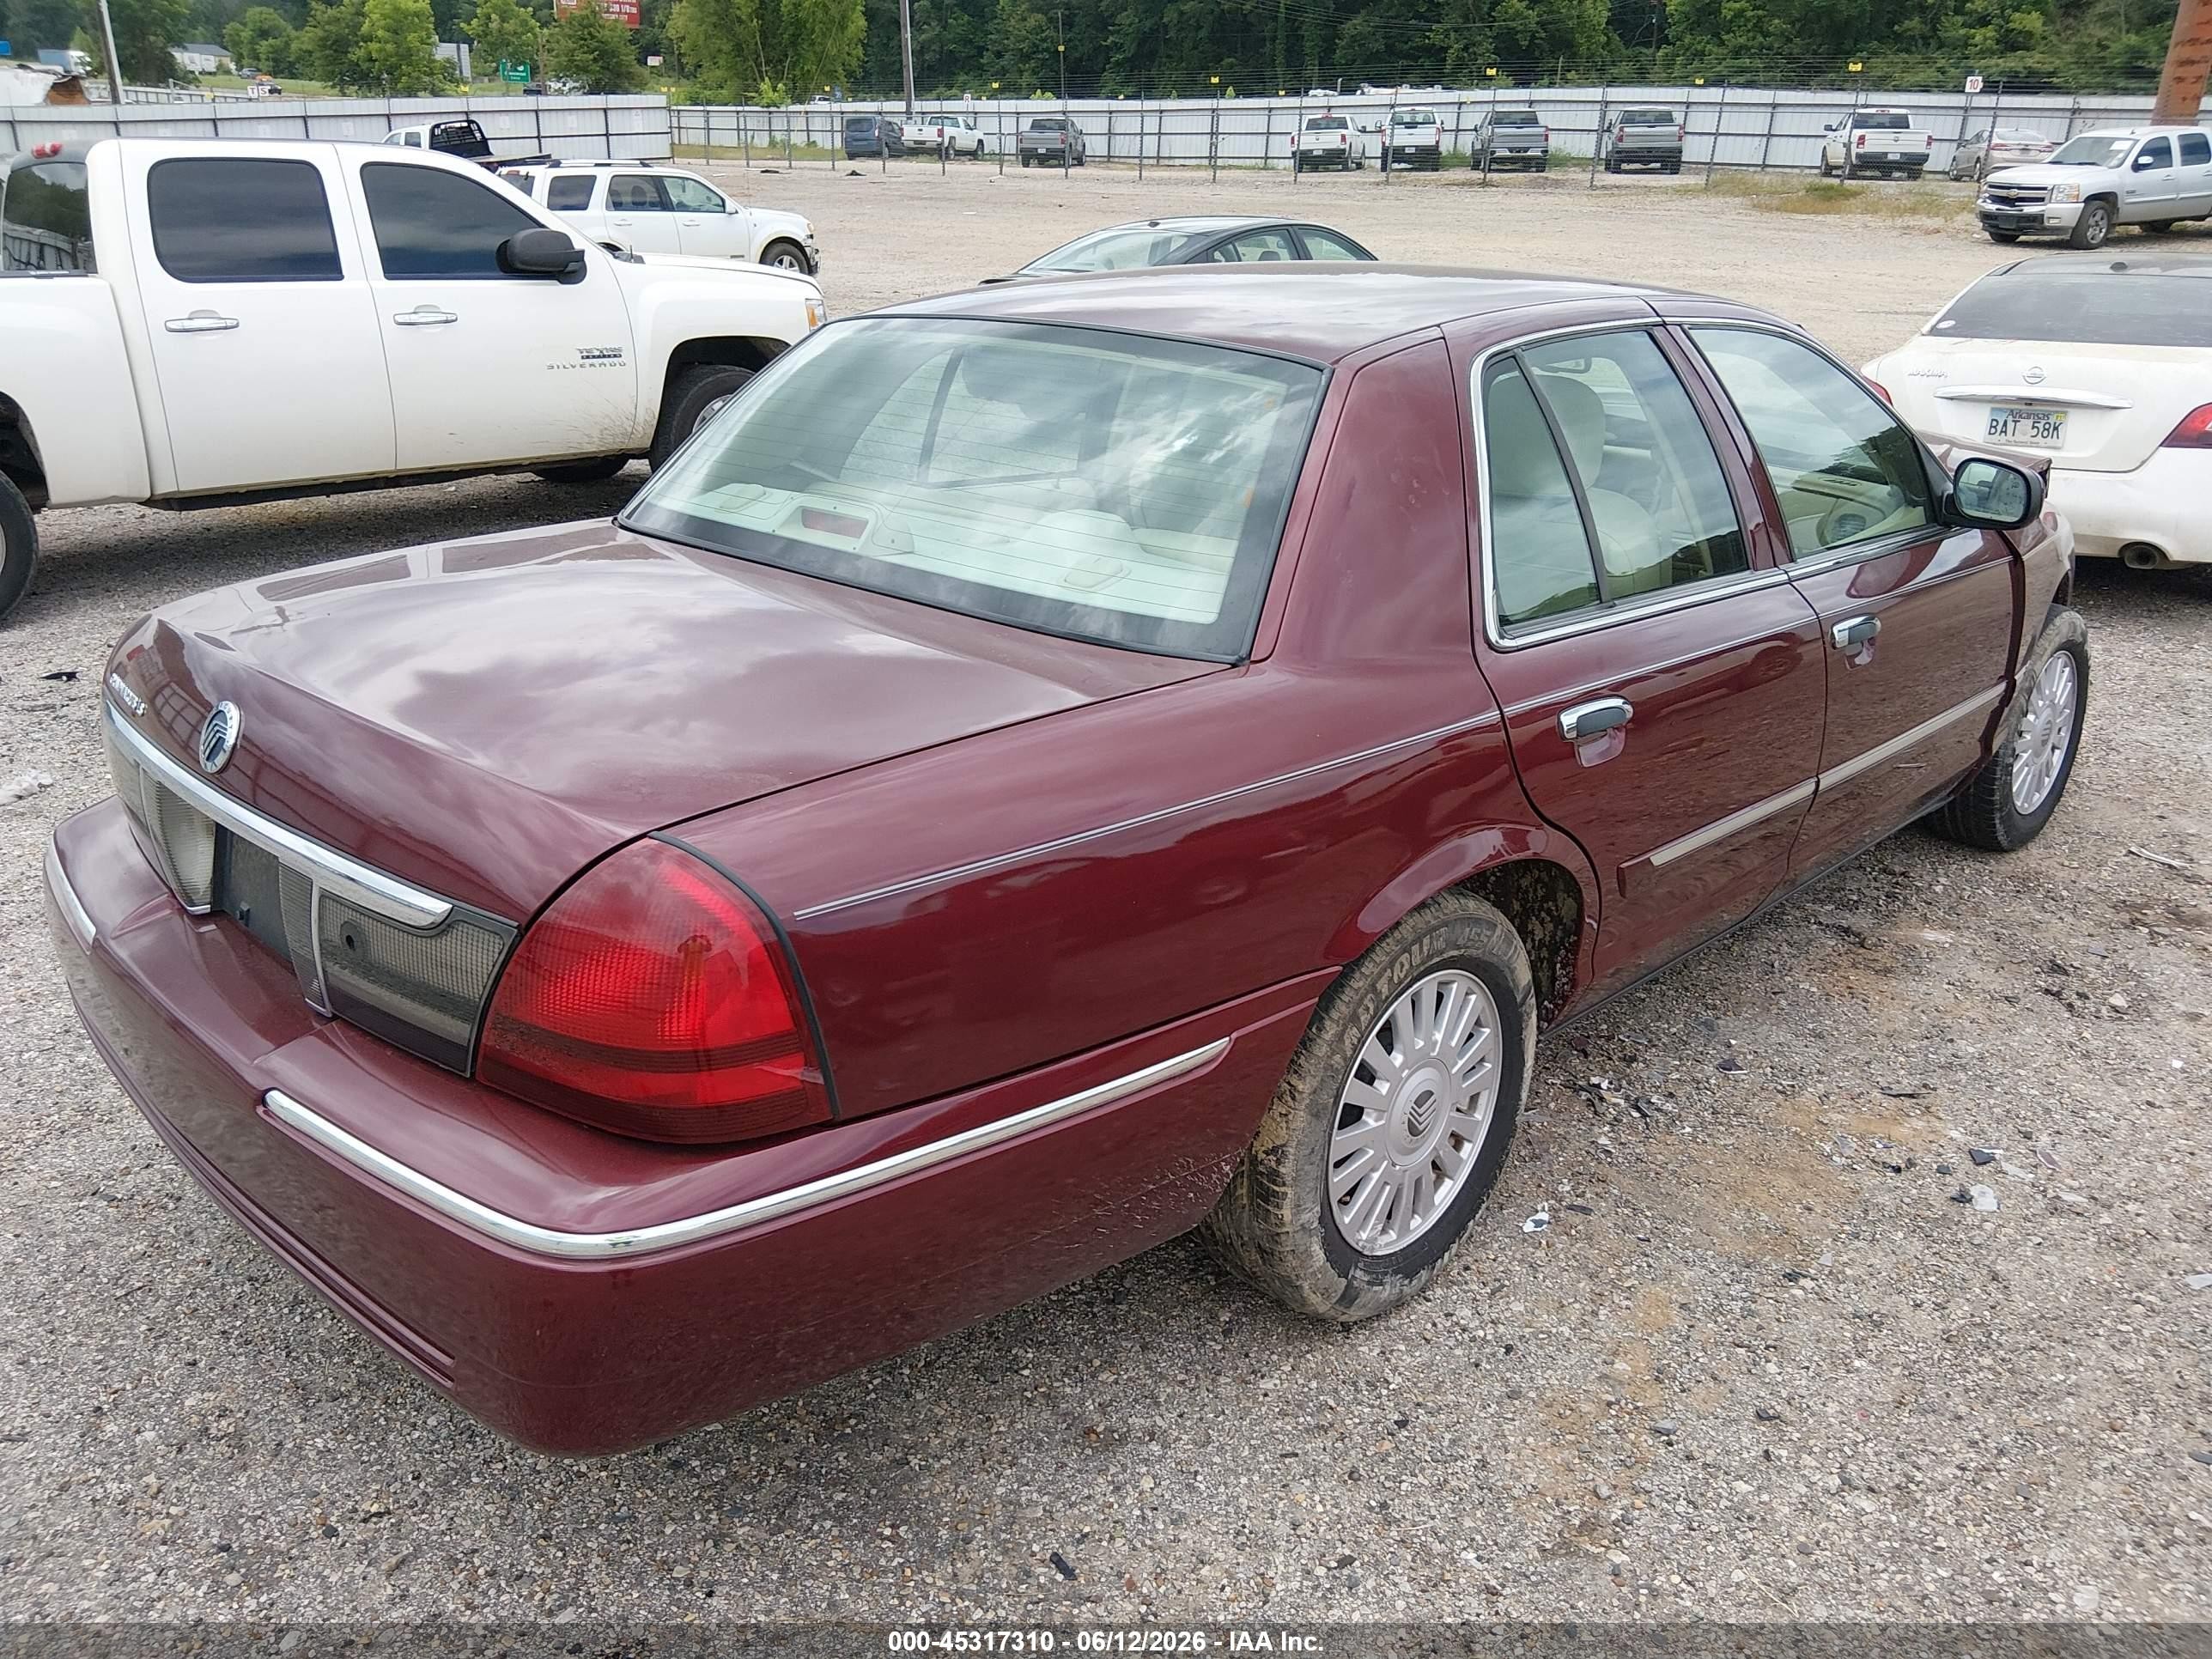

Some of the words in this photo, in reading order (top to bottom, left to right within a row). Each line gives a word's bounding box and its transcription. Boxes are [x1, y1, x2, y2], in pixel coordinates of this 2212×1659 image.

[1968, 78, 1979, 90] 10
[546, 361, 626, 370] SILVERADO
[2006, 409, 2051, 421] Arkansas
[1988, 418, 2021, 437] BAT
[2030, 420, 2063, 440] 58K
